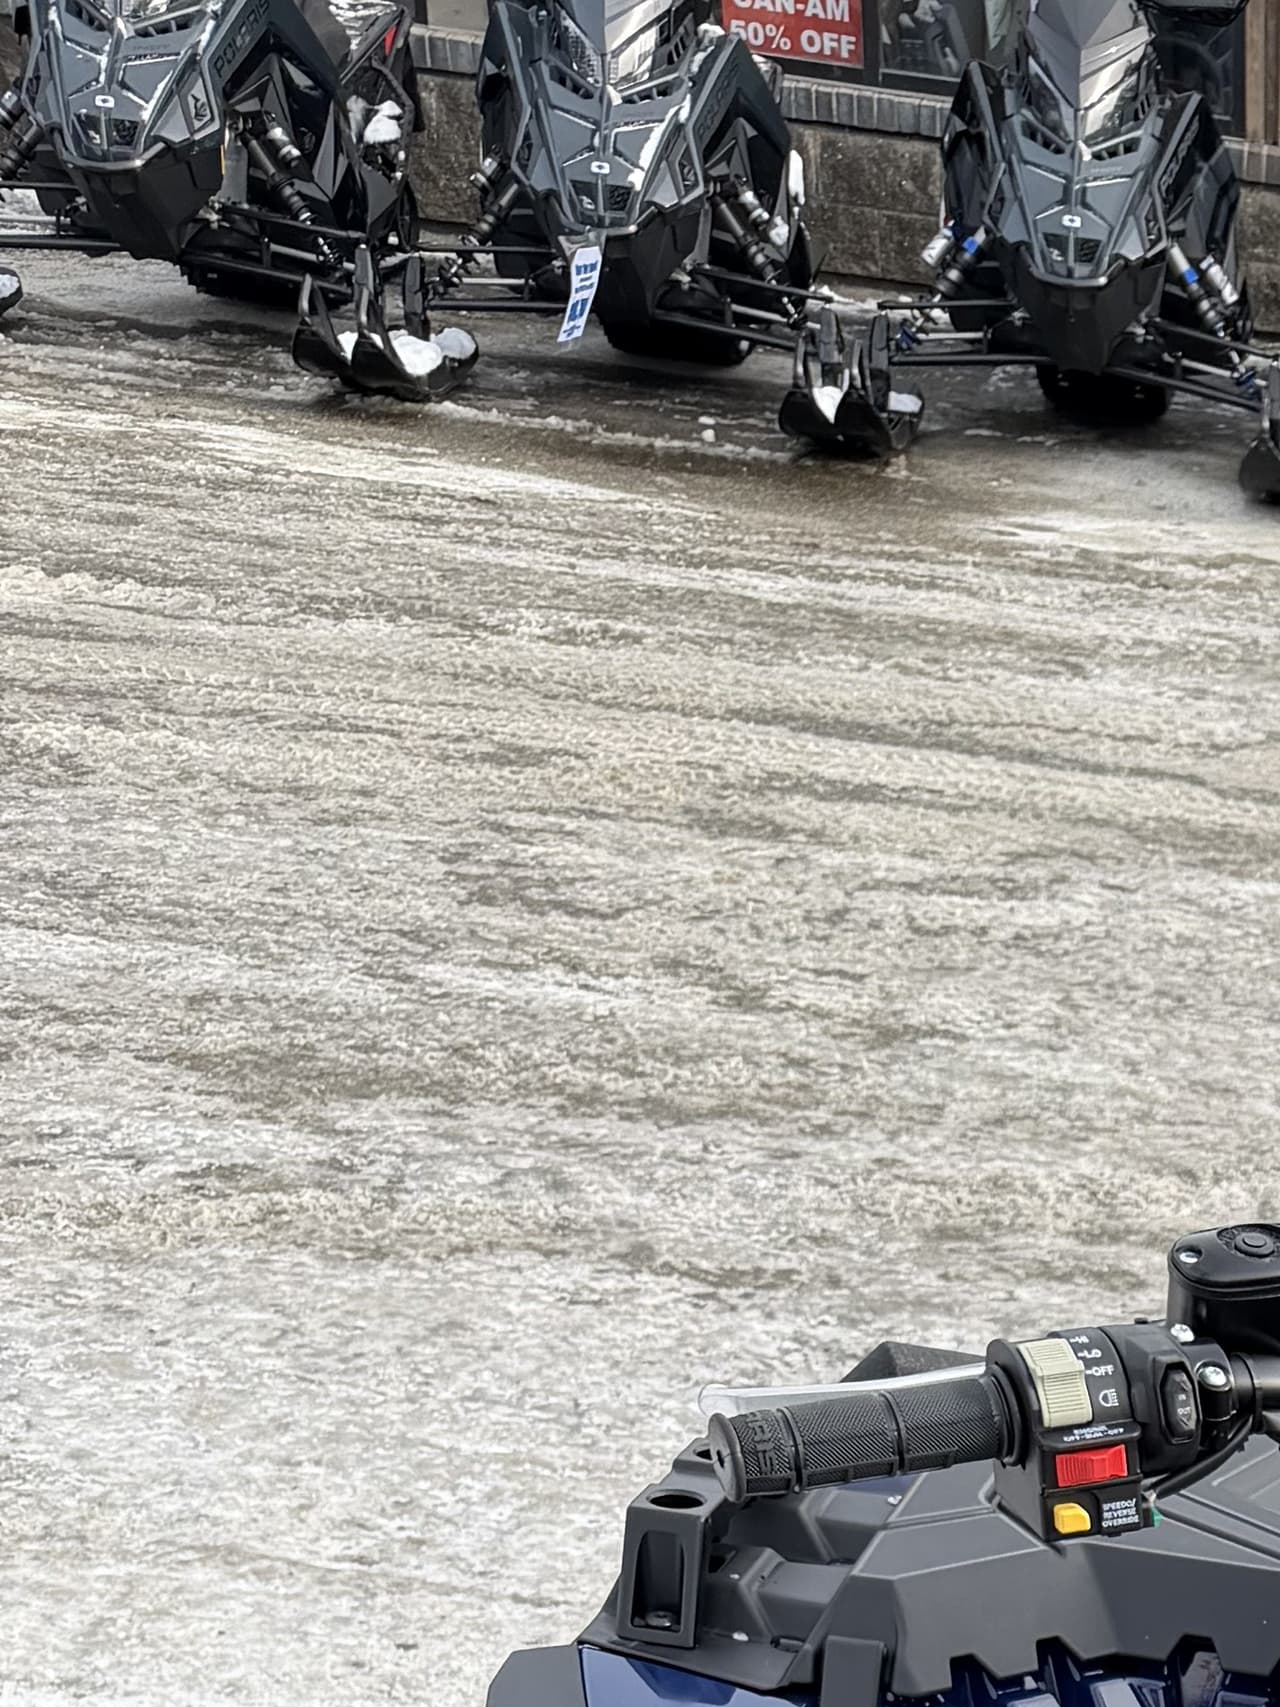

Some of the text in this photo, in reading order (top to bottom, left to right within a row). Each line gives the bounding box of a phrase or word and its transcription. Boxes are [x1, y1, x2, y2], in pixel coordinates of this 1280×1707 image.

[730, 20, 857, 59] 50% OFF
[1093, 1365, 1115, 1377] OFF
[1103, 1506, 1138, 1520] REVERSE
[1101, 1516, 1140, 1528] OVERRIDE
